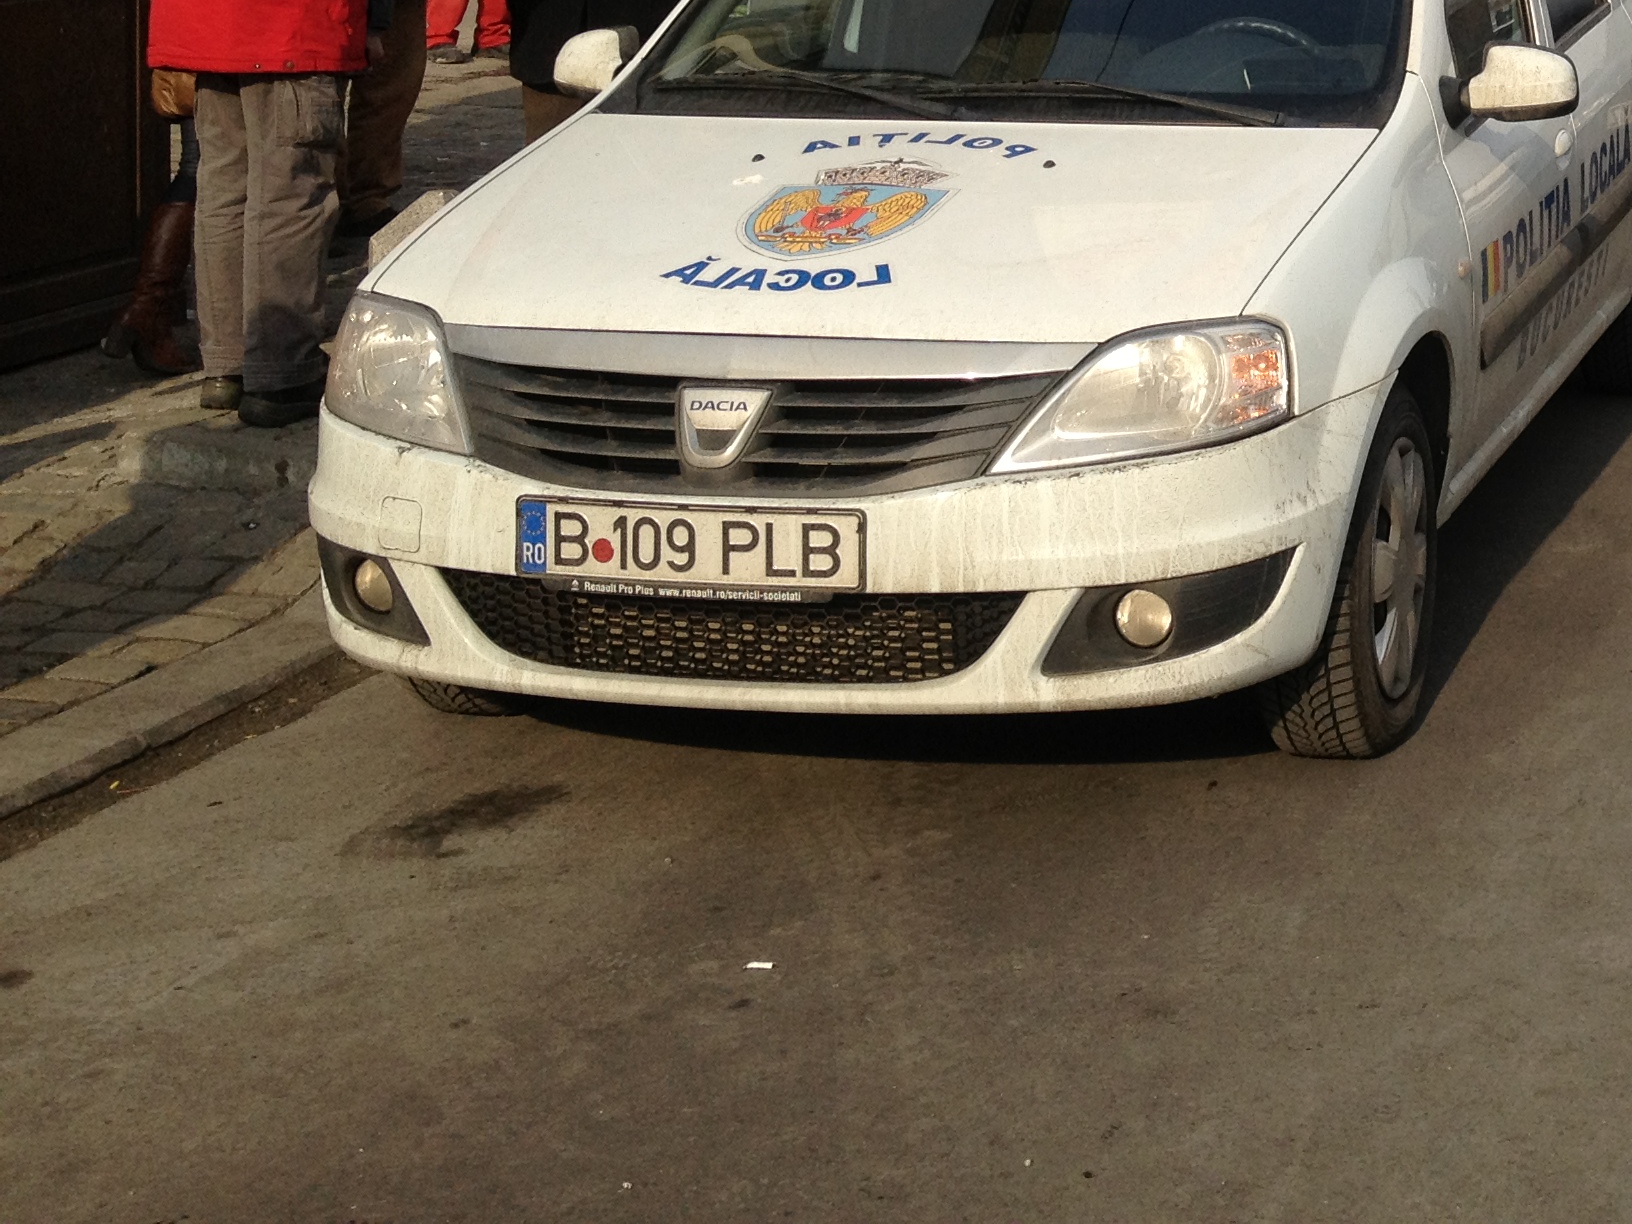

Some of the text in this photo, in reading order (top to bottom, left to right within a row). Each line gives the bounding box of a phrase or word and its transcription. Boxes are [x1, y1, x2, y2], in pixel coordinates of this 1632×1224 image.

[689, 399, 748, 413] DACIA
[523, 511, 841, 577] RO B 109 PLB
[584, 581, 617, 593] Renault
[618, 583, 634, 594] Pro
[635, 584, 654, 595] Plus
